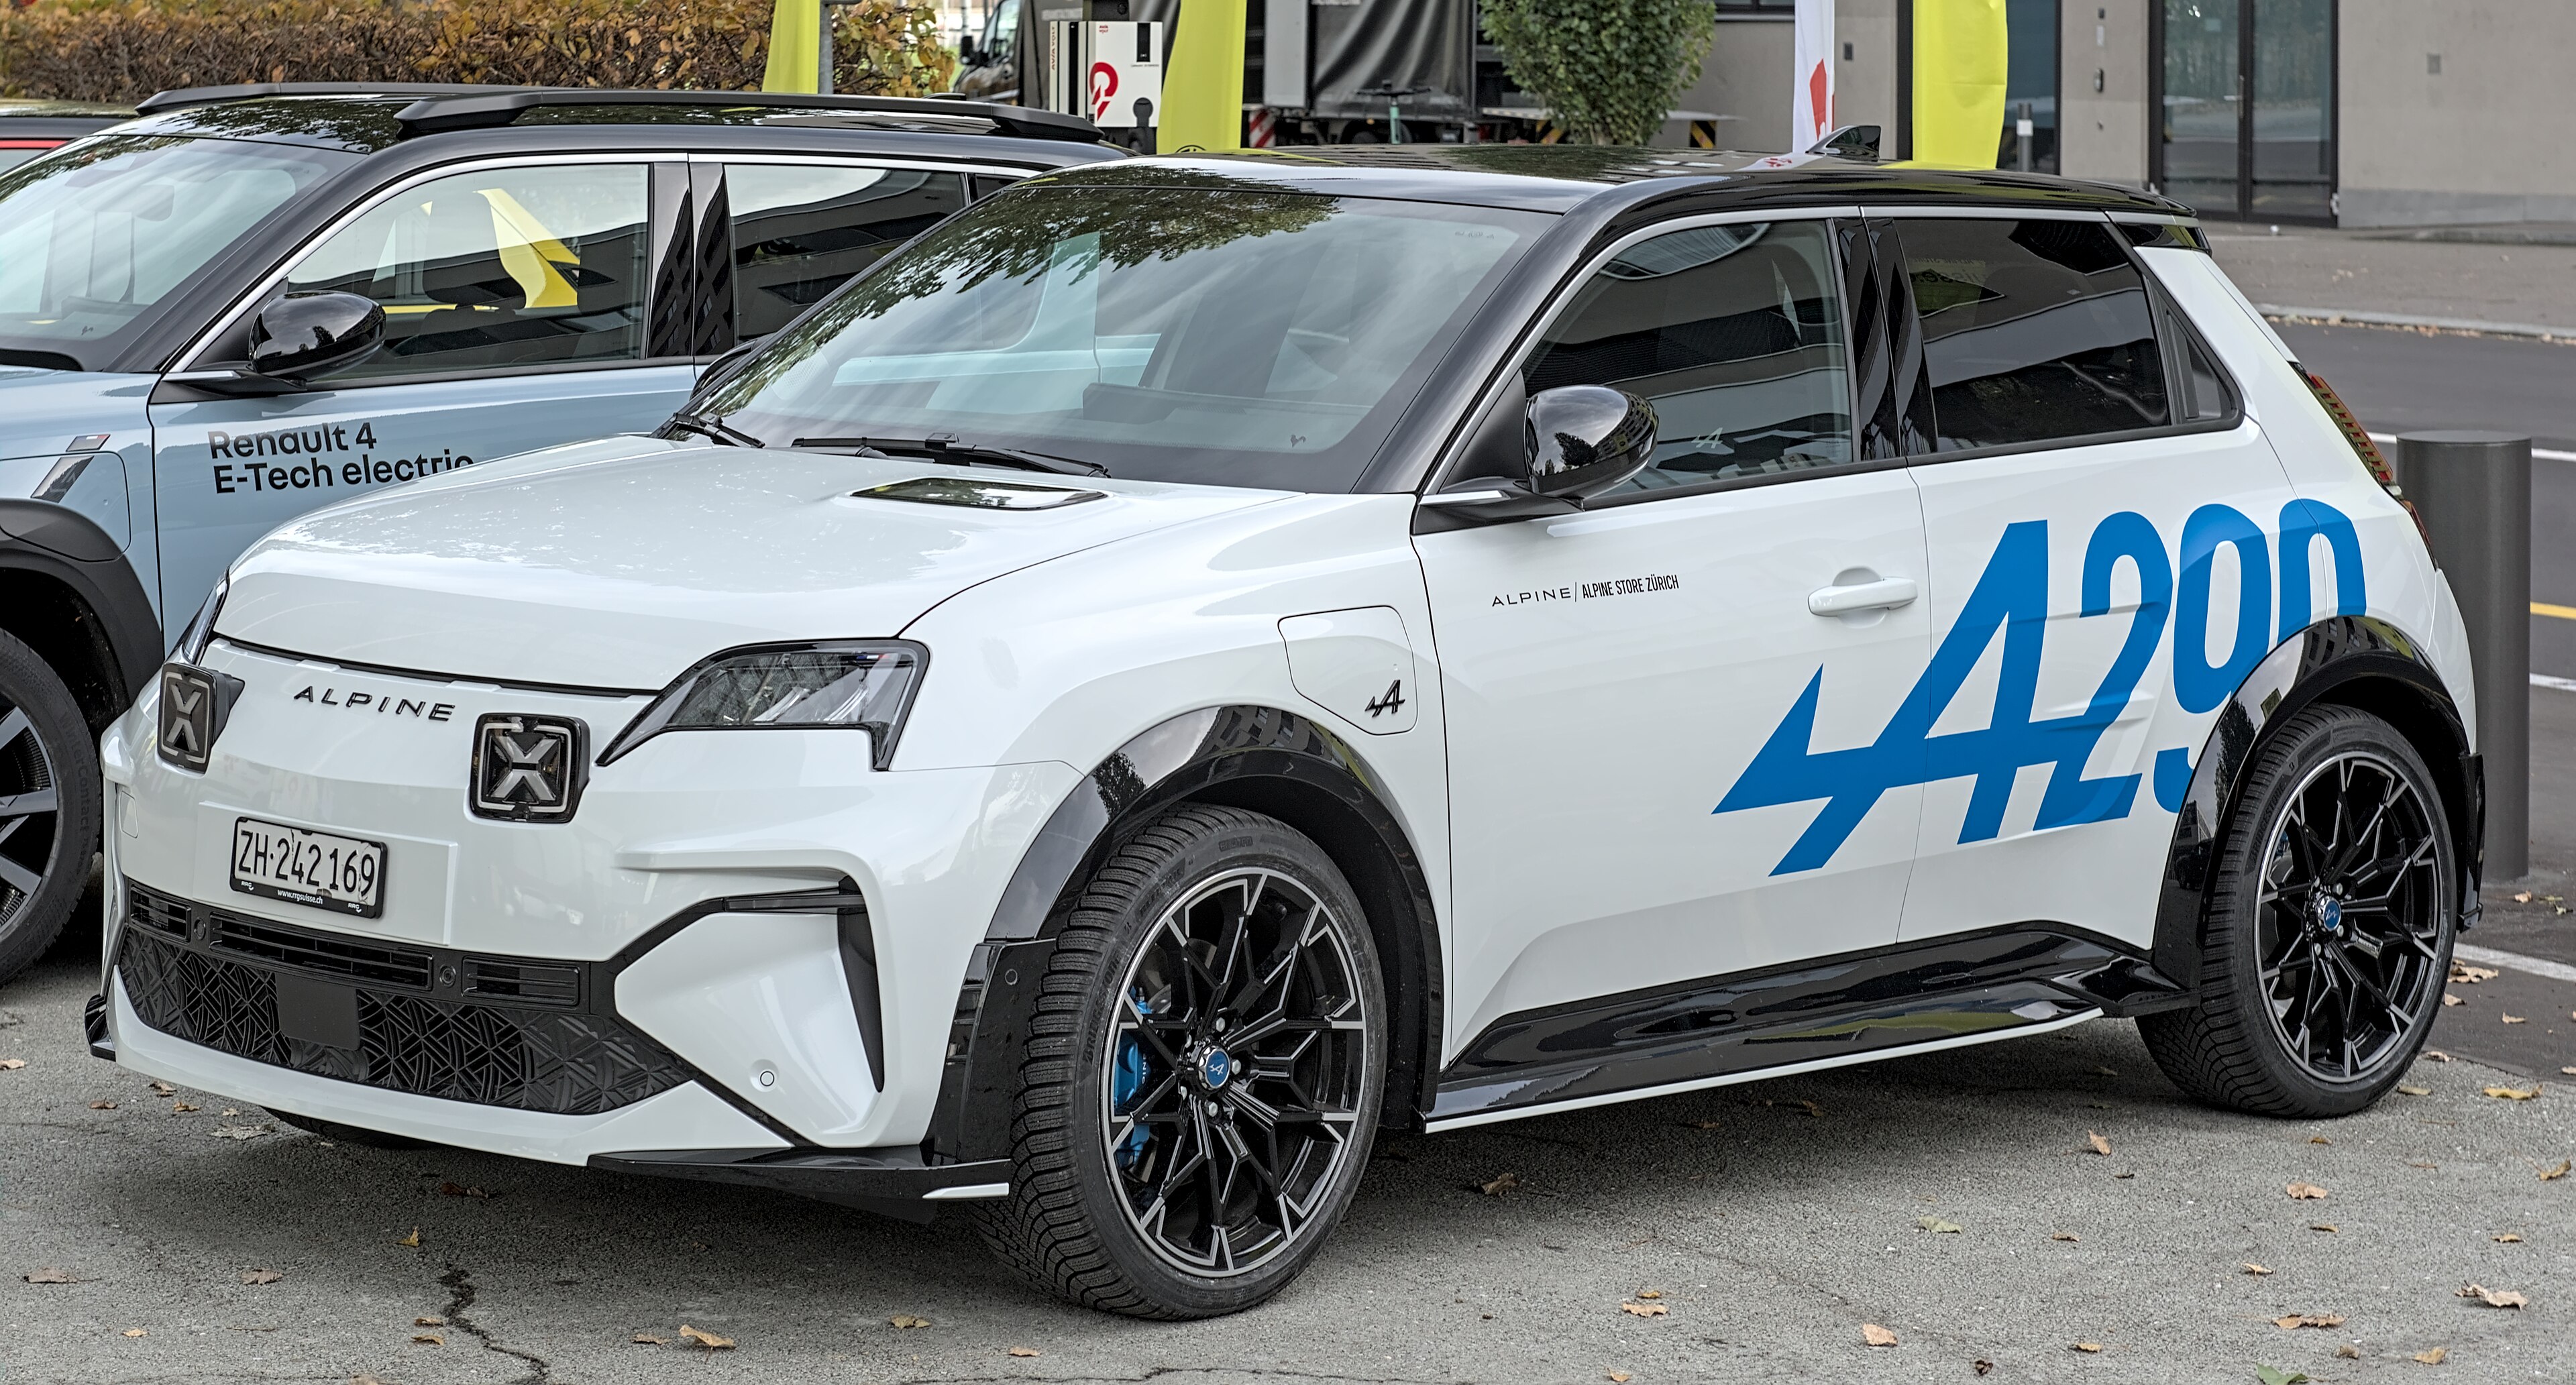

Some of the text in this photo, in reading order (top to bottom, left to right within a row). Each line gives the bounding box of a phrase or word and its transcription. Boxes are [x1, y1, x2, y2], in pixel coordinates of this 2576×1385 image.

[207, 422, 377, 459] Renault 4
[214, 457, 334, 494] E-Tech
[1492, 574, 1679, 607] ALPINE ALPINE STORE ZÜRICH
[294, 685, 455, 721] ALPINE
[241, 880, 252, 888] RRG
[329, 848, 375, 897] 169
[277, 889, 323, 904] www.rrgsuisse.ch
[347, 902, 360, 910] RRG
